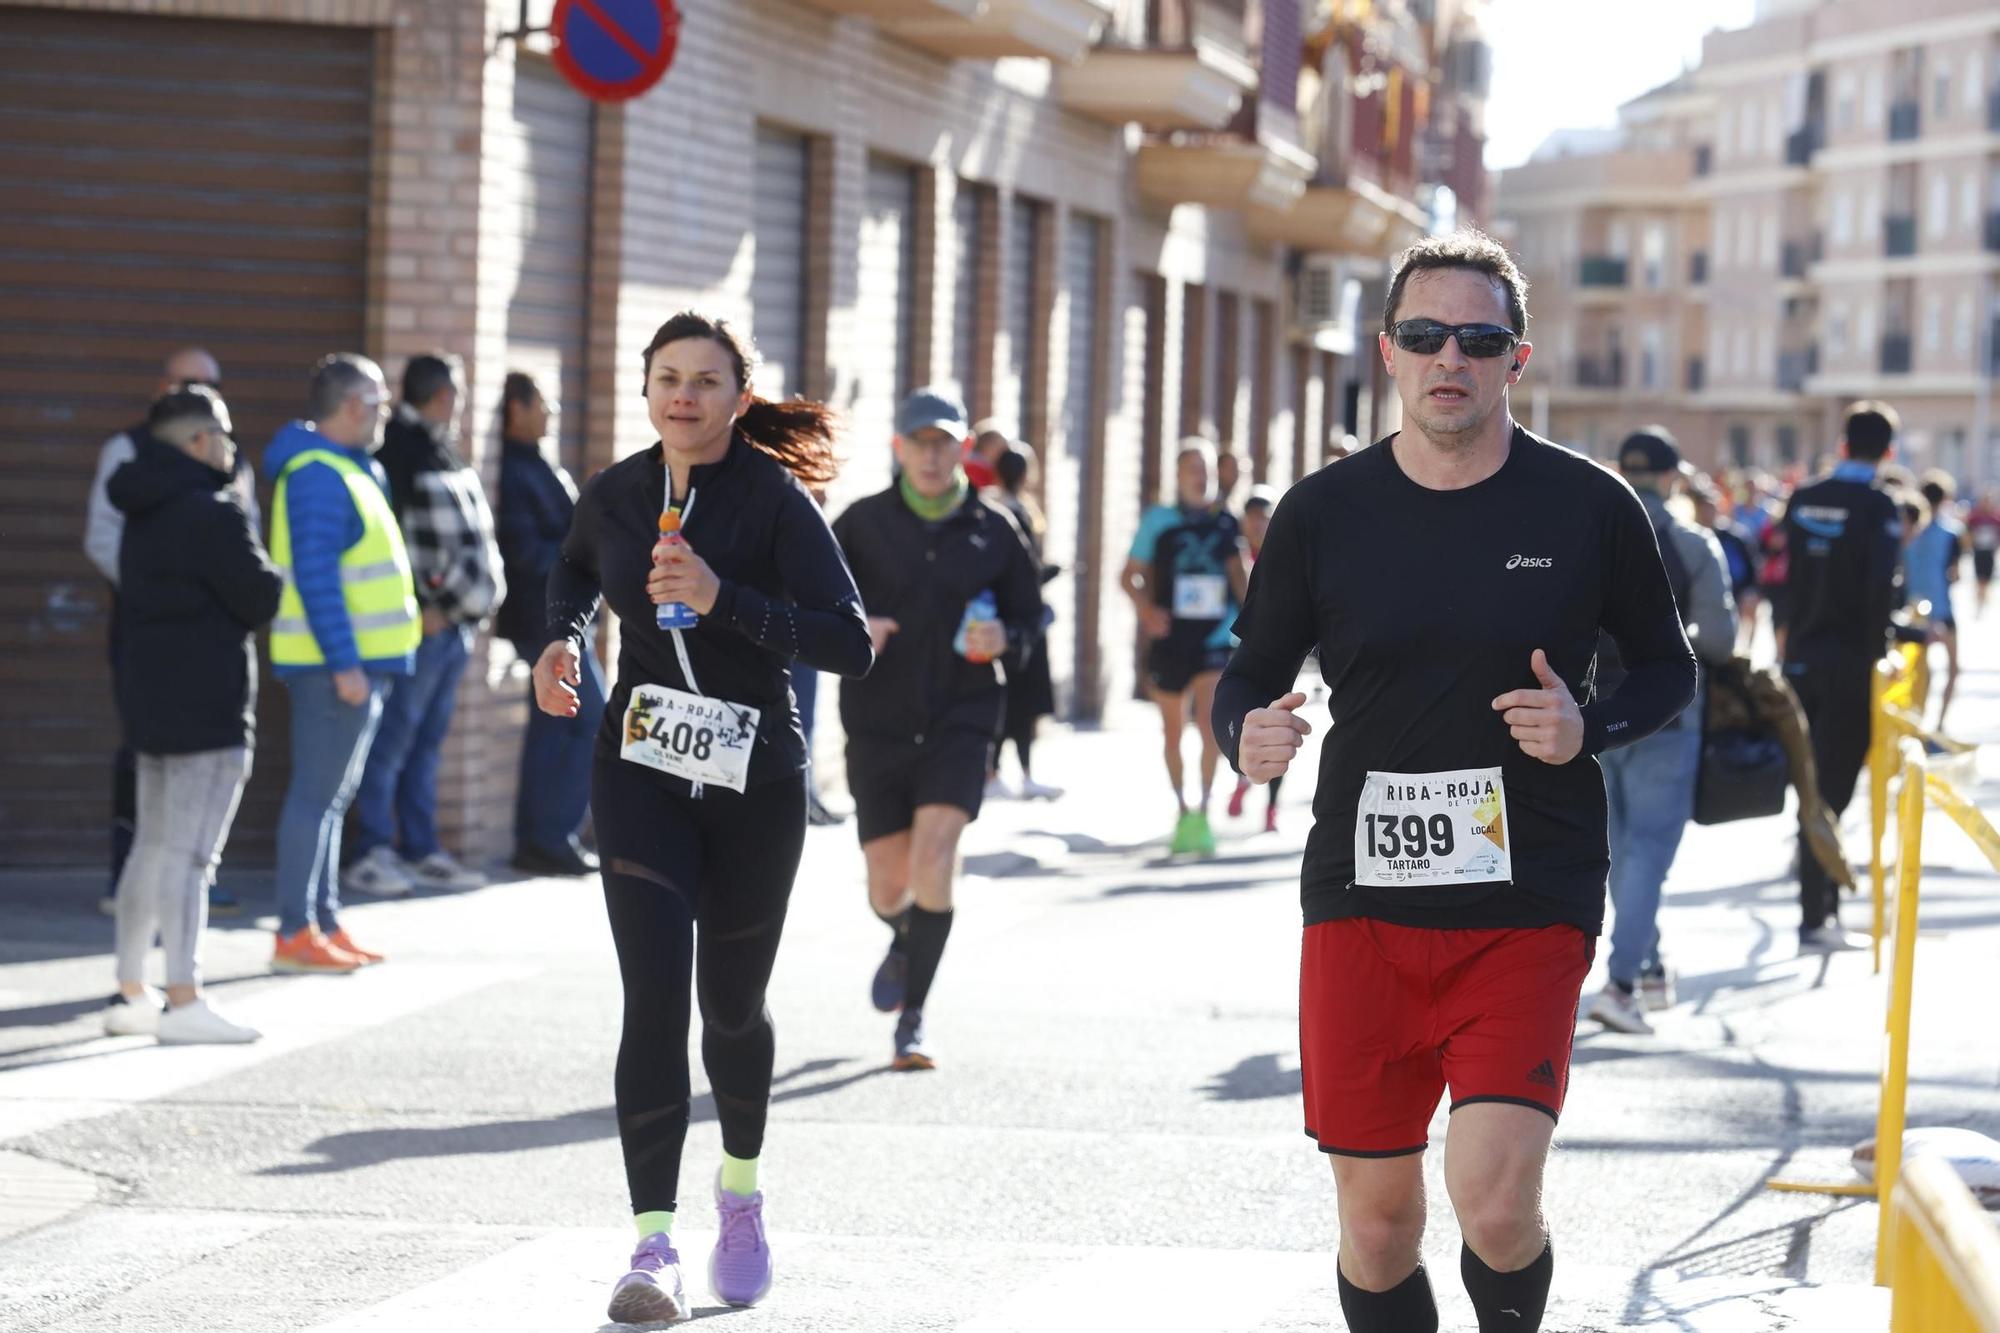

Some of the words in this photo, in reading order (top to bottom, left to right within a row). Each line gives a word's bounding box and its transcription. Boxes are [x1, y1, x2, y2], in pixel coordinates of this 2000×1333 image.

[630, 711, 714, 761] 5408
[1365, 813, 1455, 858] 1399
[1471, 825, 1497, 835] LOCAL
[1387, 859, 1430, 870] TARTARO
